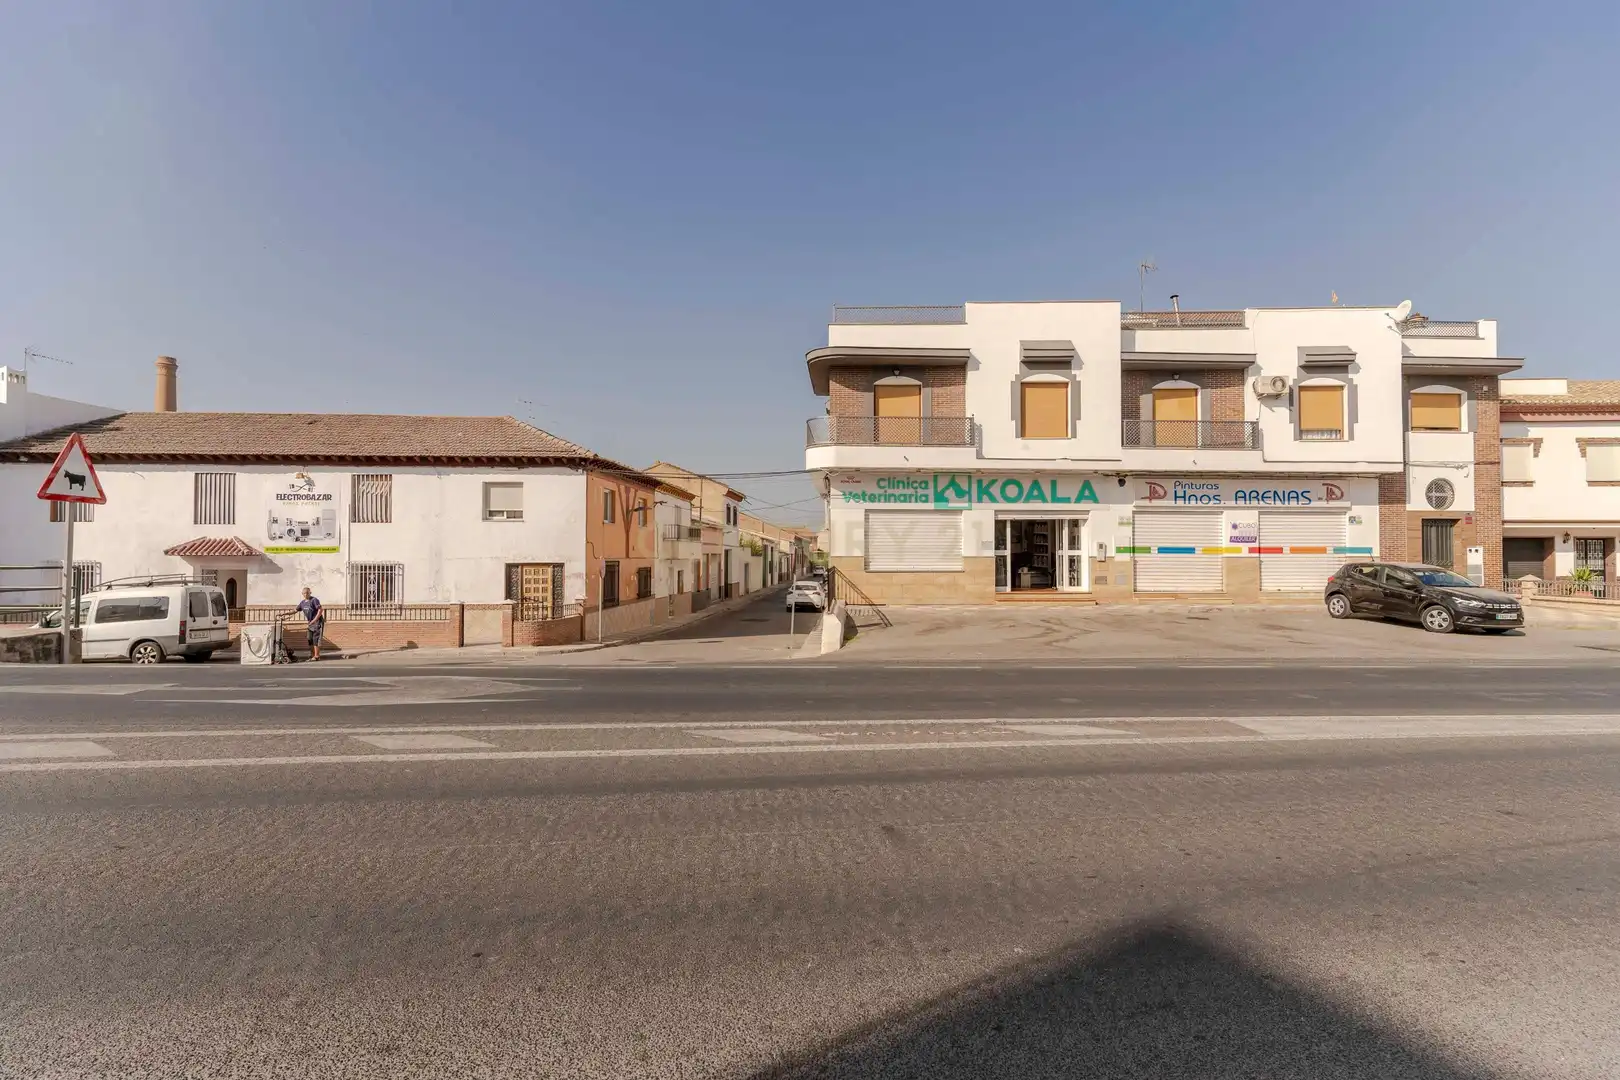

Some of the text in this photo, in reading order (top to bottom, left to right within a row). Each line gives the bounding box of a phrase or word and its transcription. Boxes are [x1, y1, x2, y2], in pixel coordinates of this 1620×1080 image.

[876, 475, 930, 490] Clínica
[1174, 480, 1219, 490] Pinturas
[276, 493, 332, 501] ELECTROBAZAR
[842, 489, 930, 504] Veterinaria
[976, 479, 1100, 504] KOALA
[1174, 489, 1312, 505] Hnos. ARENAS
